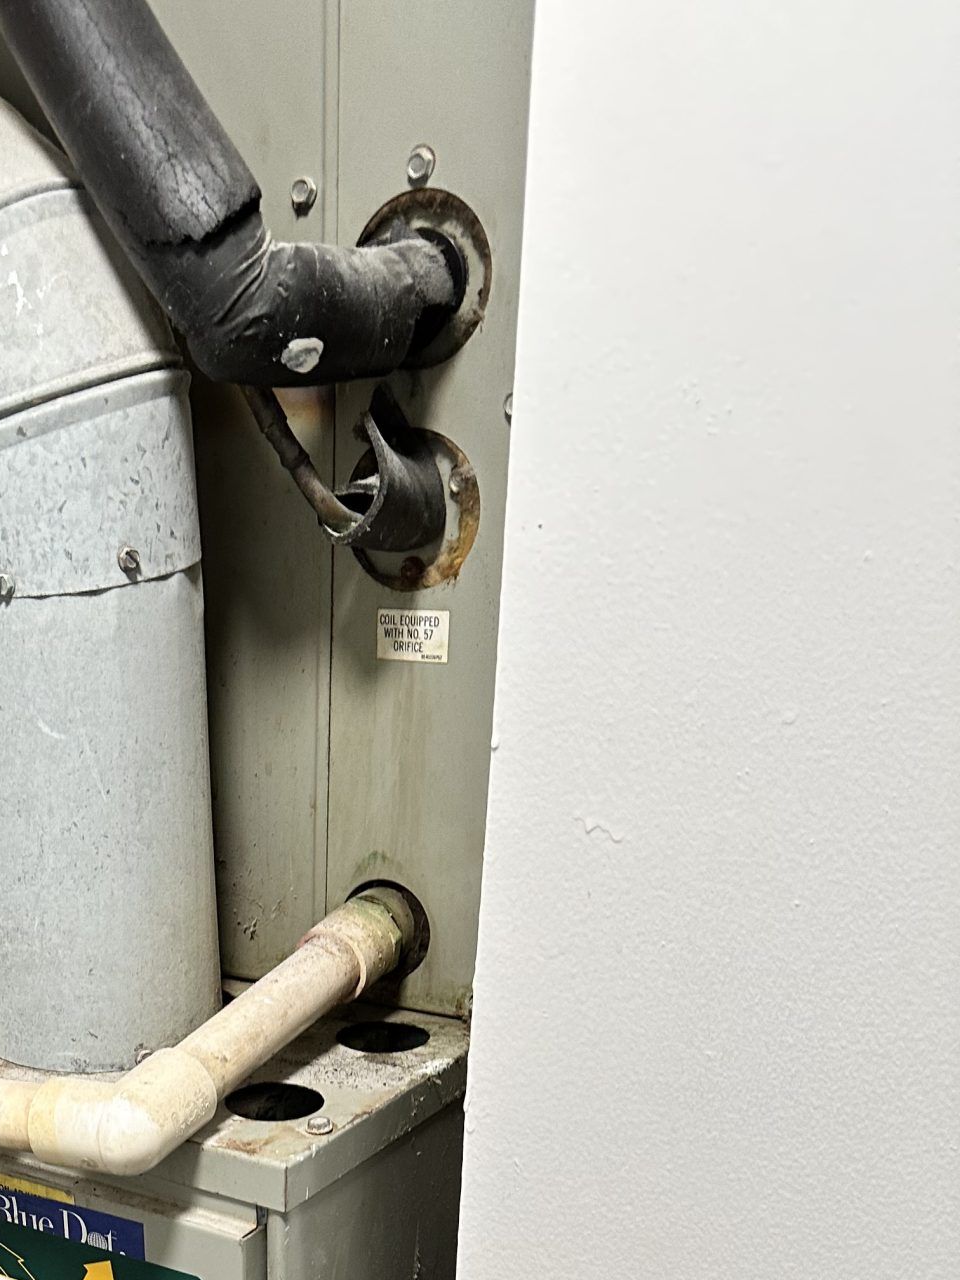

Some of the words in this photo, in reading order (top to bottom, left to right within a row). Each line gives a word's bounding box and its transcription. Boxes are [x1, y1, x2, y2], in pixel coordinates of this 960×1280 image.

[379, 614, 398, 626] COIL
[400, 615, 440, 628] EQUIPPED
[383, 628, 404, 639] WITH
[406, 629, 421, 640] NO.
[423, 629, 434, 640] 57
[393, 640, 424, 653] ORIFICE
